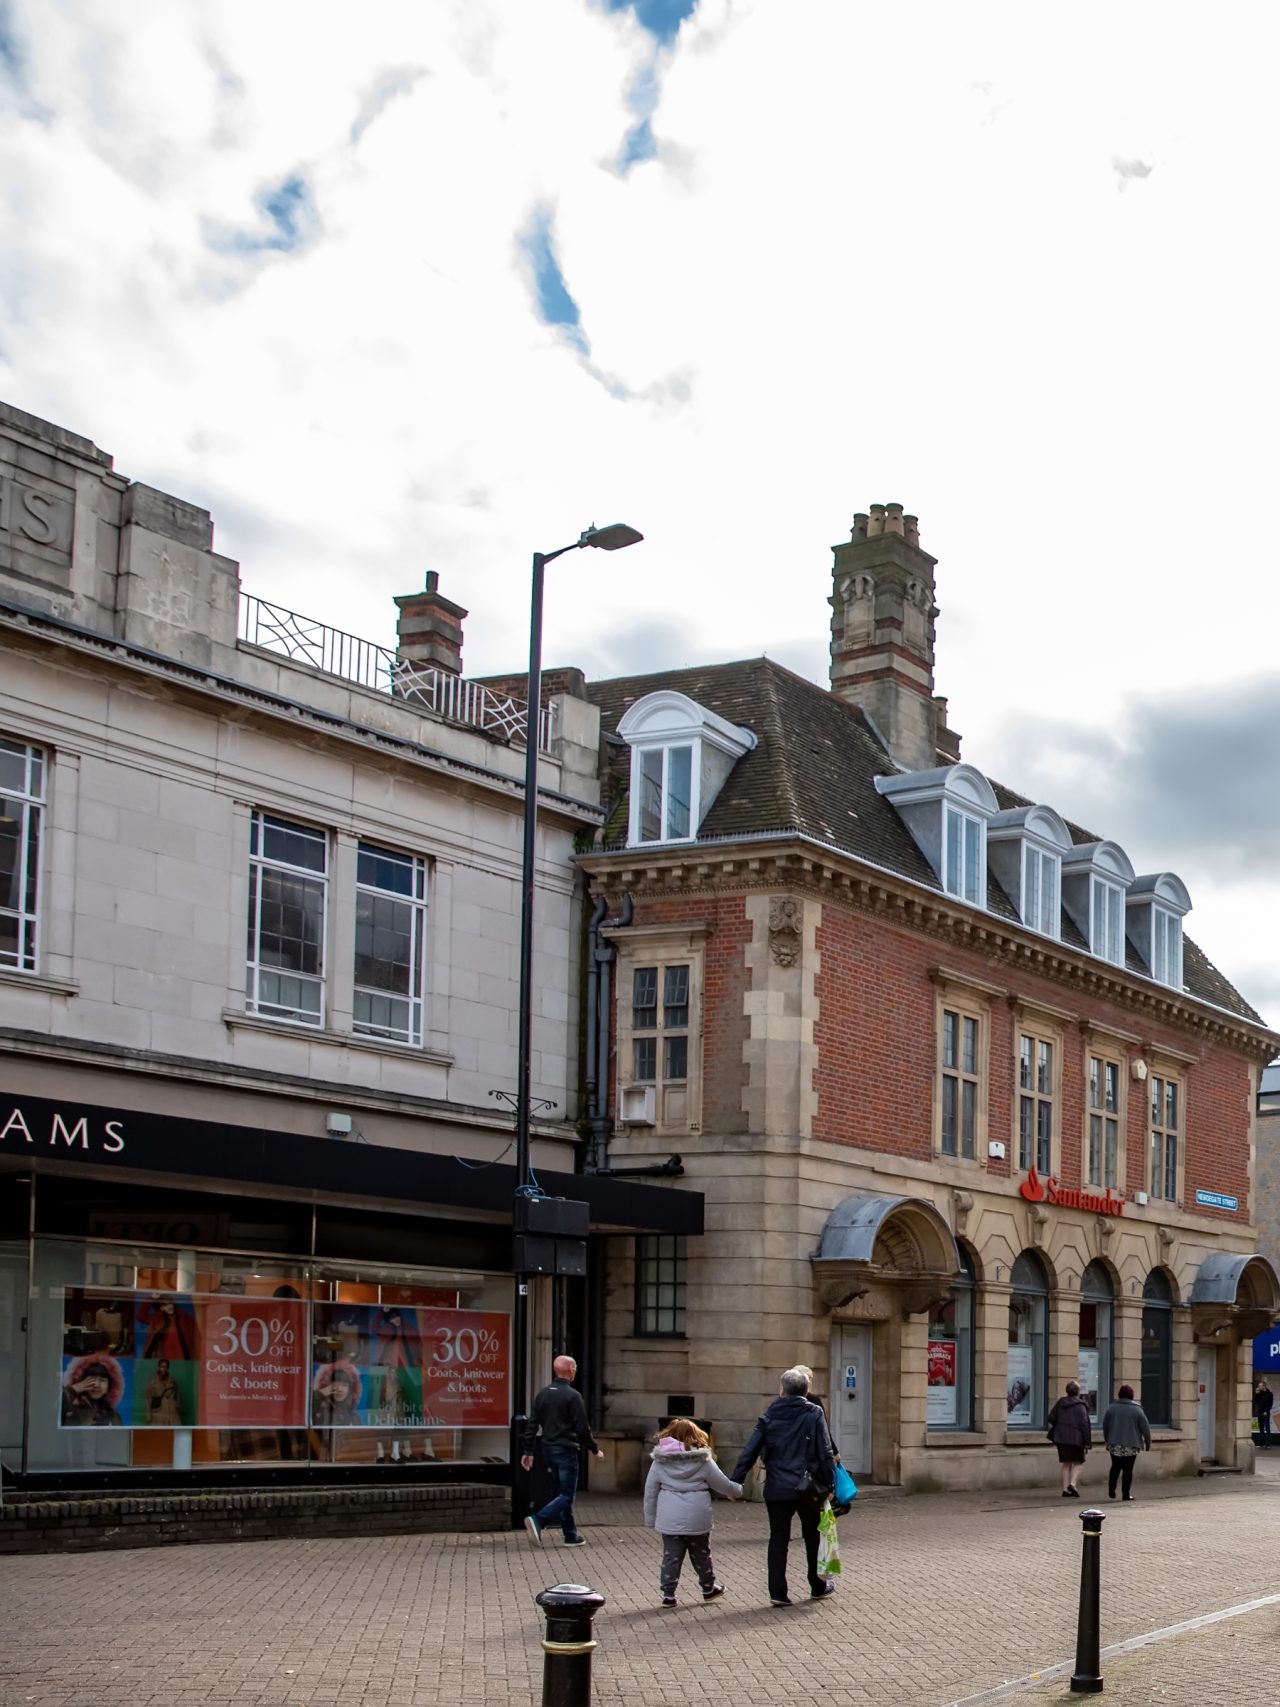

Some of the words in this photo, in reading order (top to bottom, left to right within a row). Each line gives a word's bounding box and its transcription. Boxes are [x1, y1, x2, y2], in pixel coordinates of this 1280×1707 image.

[0, 1108, 125, 1152] AMS
[1046, 1177, 1125, 1216] Santander
[213, 1316, 294, 1357] 30%
[269, 1346, 294, 1357] OFF
[432, 1327, 499, 1363] 30%
[479, 1354, 499, 1363] OFF
[206, 1359, 247, 1373] Coats,
[250, 1361, 301, 1375] knitwear
[427, 1366, 461, 1379] Coats,
[464, 1367, 505, 1380] knitwear
[230, 1377, 241, 1389] &
[244, 1377, 280, 1390] boots
[447, 1382, 456, 1393] &
[459, 1382, 487, 1393] boots
[367, 1412, 446, 1426] Debenhams
